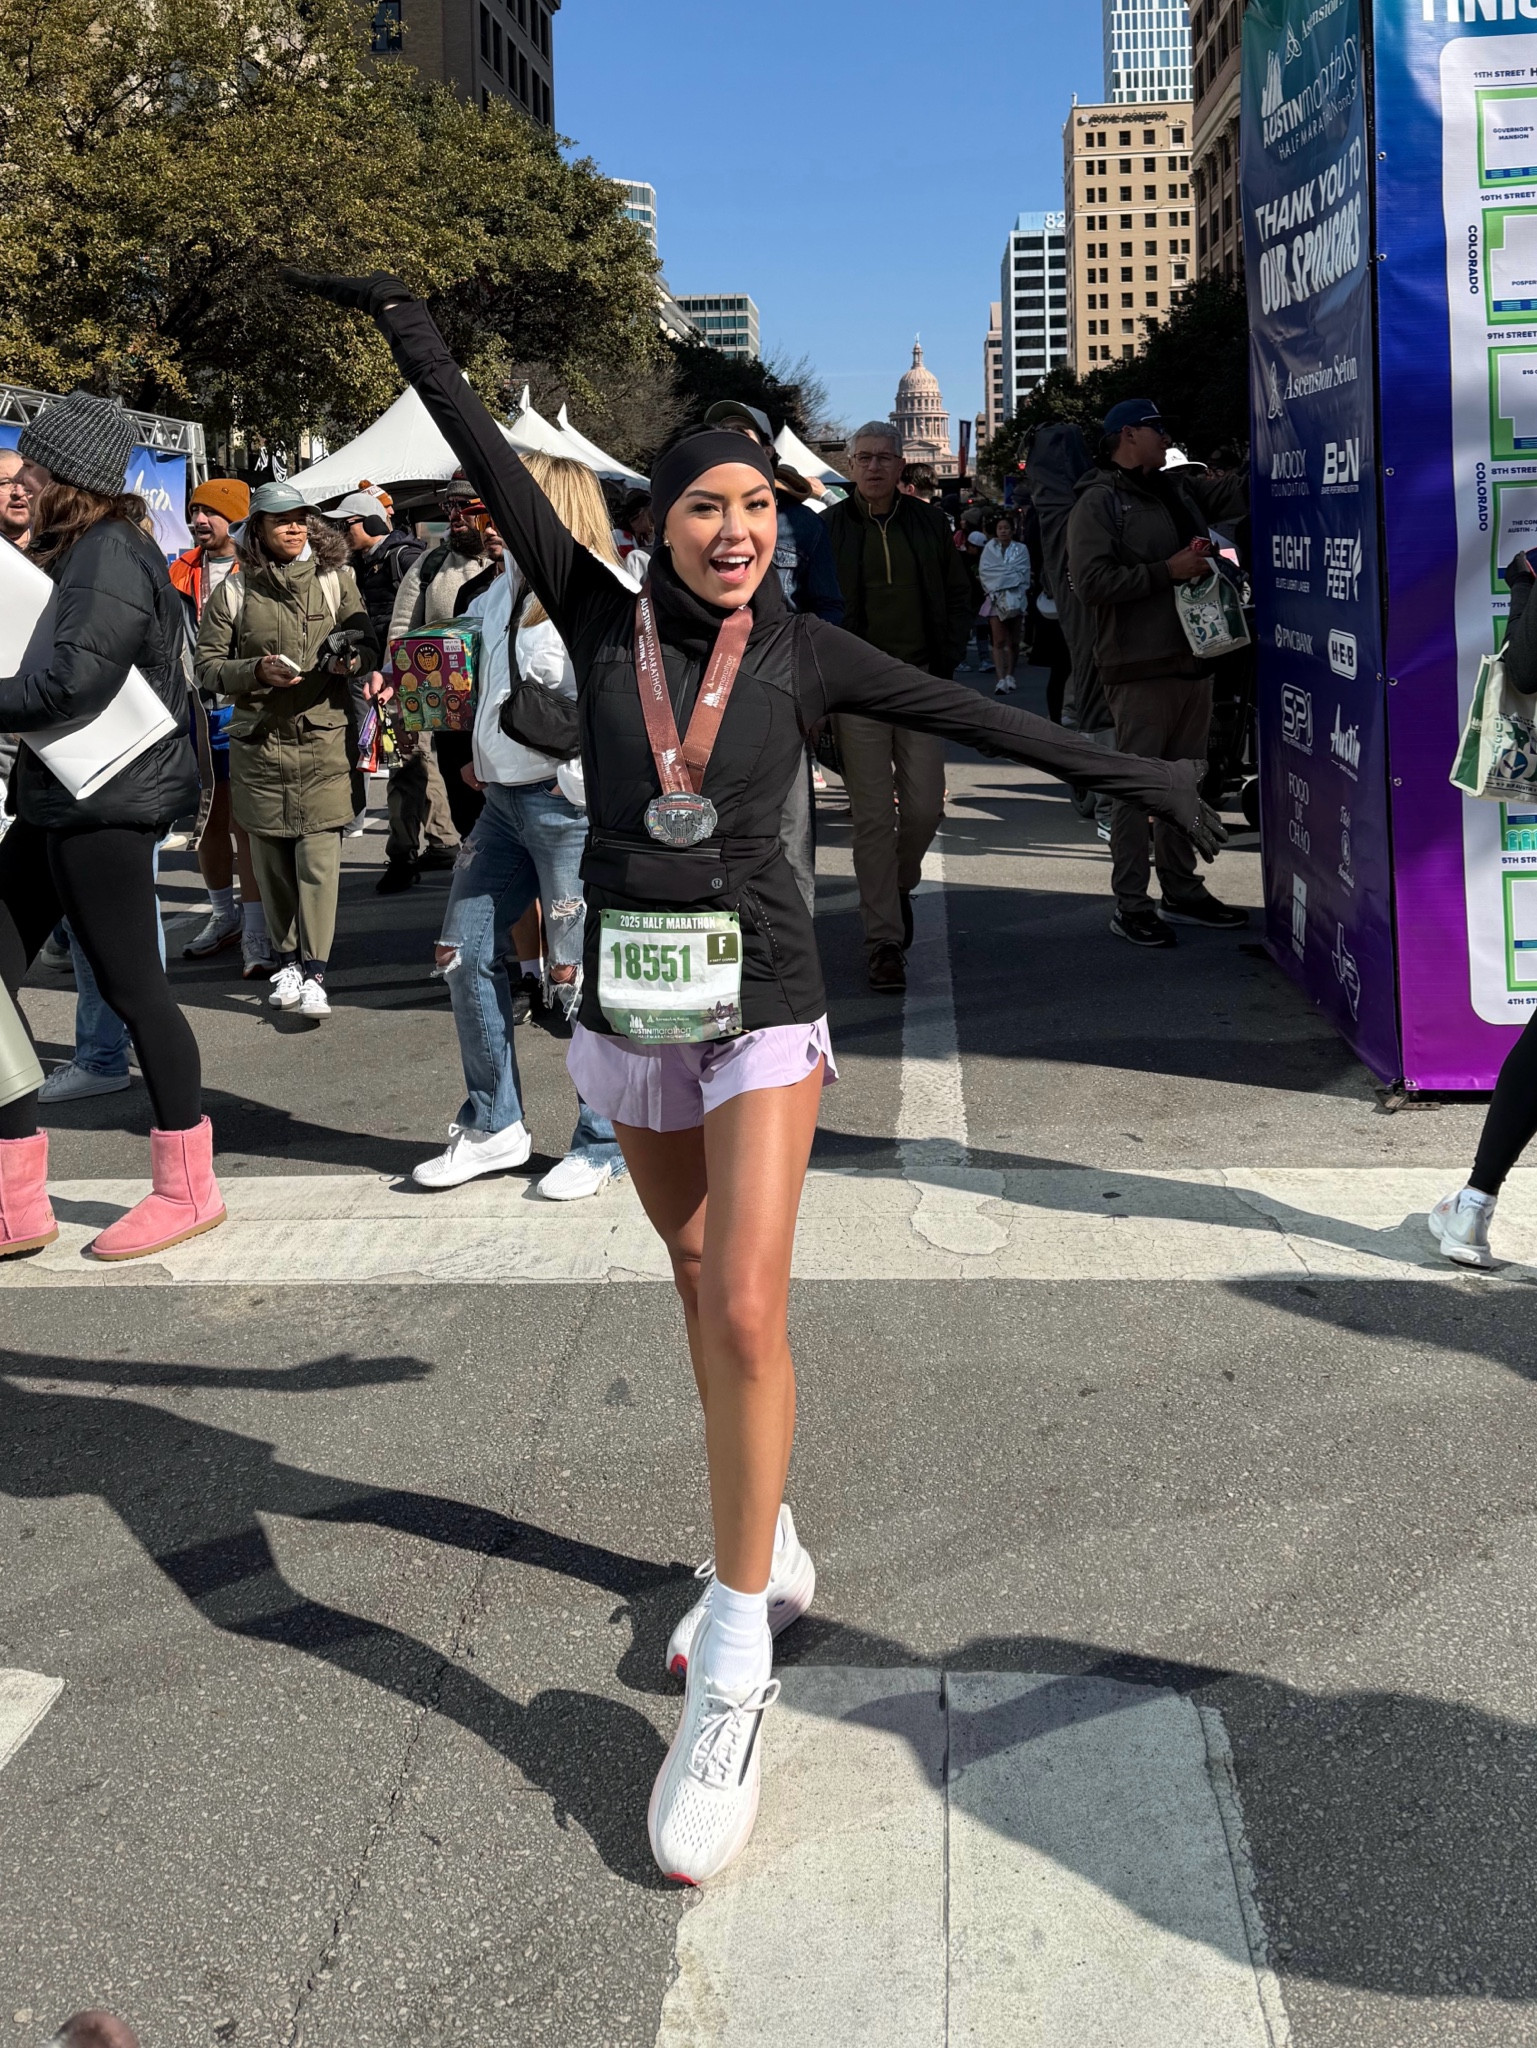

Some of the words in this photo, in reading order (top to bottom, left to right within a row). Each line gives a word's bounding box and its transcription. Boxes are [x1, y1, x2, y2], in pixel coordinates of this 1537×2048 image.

[1494, 69, 1526, 78] STREET
[1498, 133, 1529, 141] MANSION
[1255, 178, 1316, 243] THANK
[1318, 153, 1347, 212] YOU
[1349, 135, 1361, 187] TO
[1480, 193, 1502, 202] 10TH
[1504, 191, 1536, 200] STREET
[1260, 243, 1292, 316] OUR
[1292, 190, 1361, 302] SPONSORS
[1467, 224, 1480, 295] COLORADO
[1487, 332, 1505, 340] 9TH
[1506, 330, 1537, 339] STREET
[1283, 360, 1333, 400] Ascension
[1333, 354, 1358, 387] Seton
[1491, 467, 1509, 476] 8TH
[1475, 462, 1488, 532] COLORADO
[1272, 535, 1311, 571] EIGHT
[1326, 568, 1352, 601] FEET
[1288, 772, 1310, 806] FOGO
[620, 915, 640, 928] 2025
[642, 916, 664, 930] HALF
[666, 916, 716, 930] MARATHON
[610, 941, 692, 983] 18551
[718, 936, 727, 955] F
